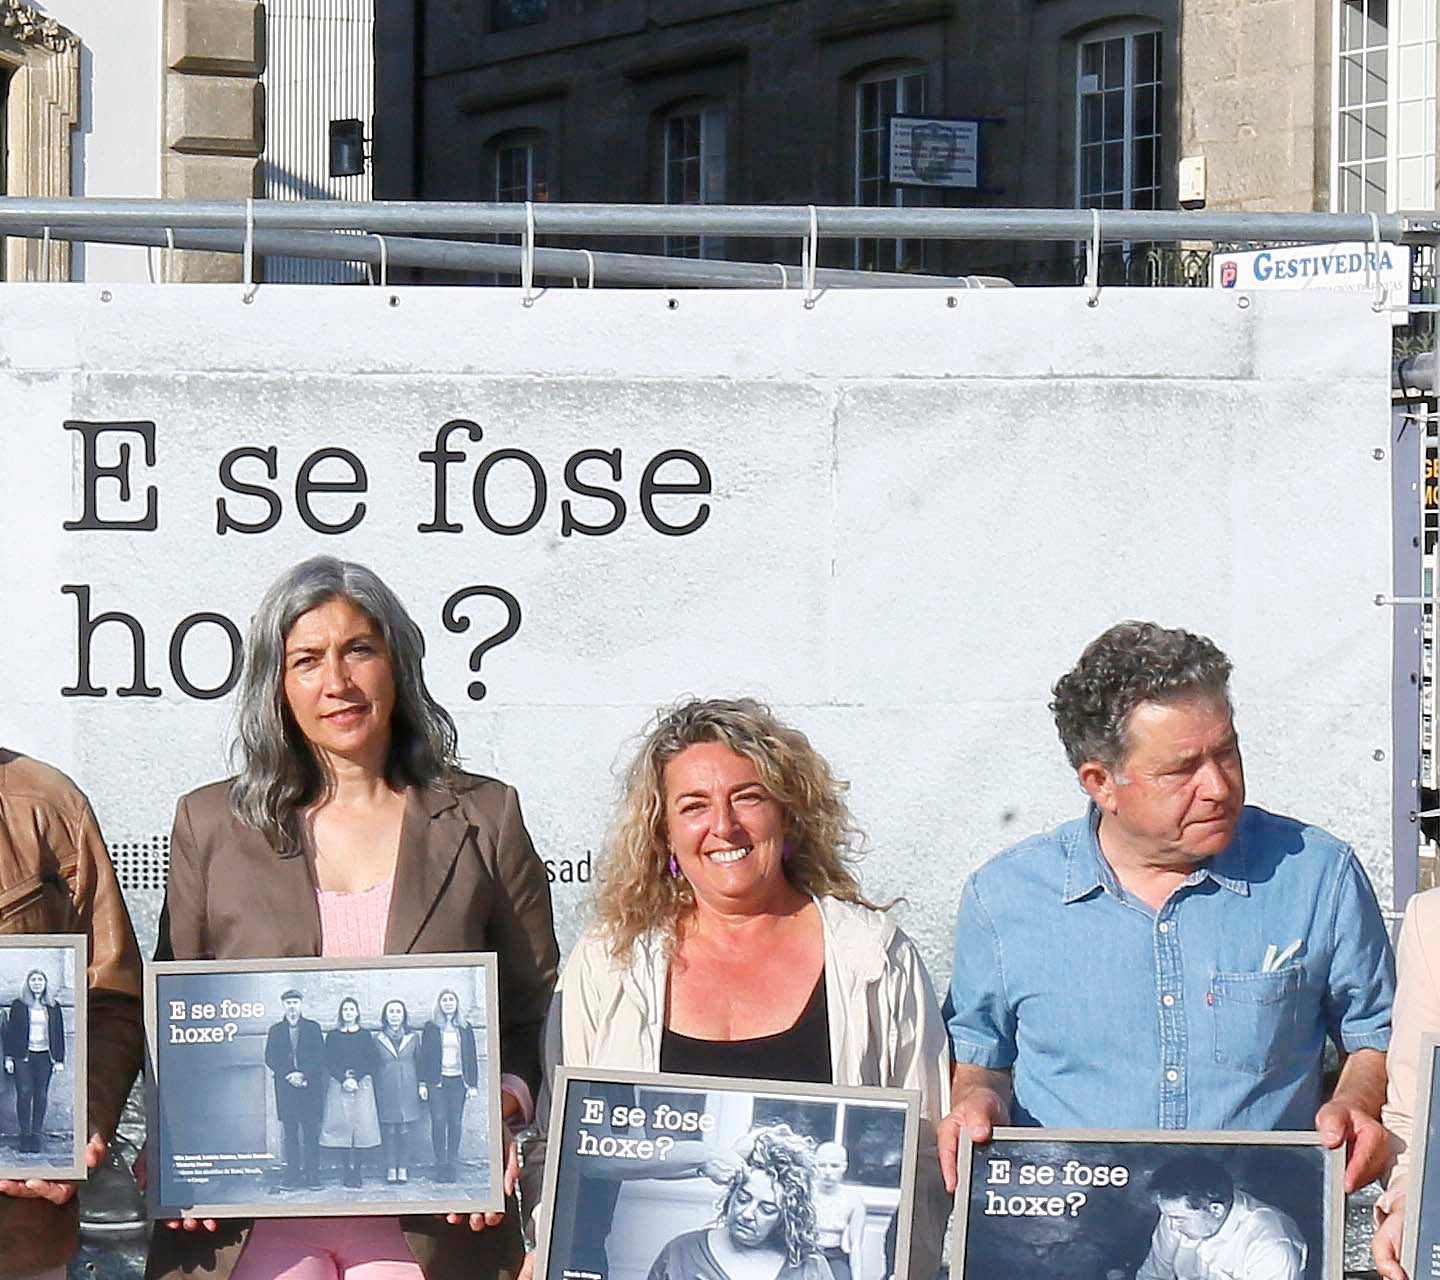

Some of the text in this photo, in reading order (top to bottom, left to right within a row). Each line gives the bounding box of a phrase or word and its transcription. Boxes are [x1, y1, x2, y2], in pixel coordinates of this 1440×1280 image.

[62, 418, 713, 538] E se fose
[61, 585, 522, 701] ho?
[168, 999, 265, 1020] E se fose
[168, 1023, 237, 1045] hoxe?
[580, 1099, 716, 1133] E se fose
[576, 1130, 674, 1161] hoxe?
[986, 1159, 1129, 1187] E se fose
[984, 1190, 1086, 1217] hoxe?
